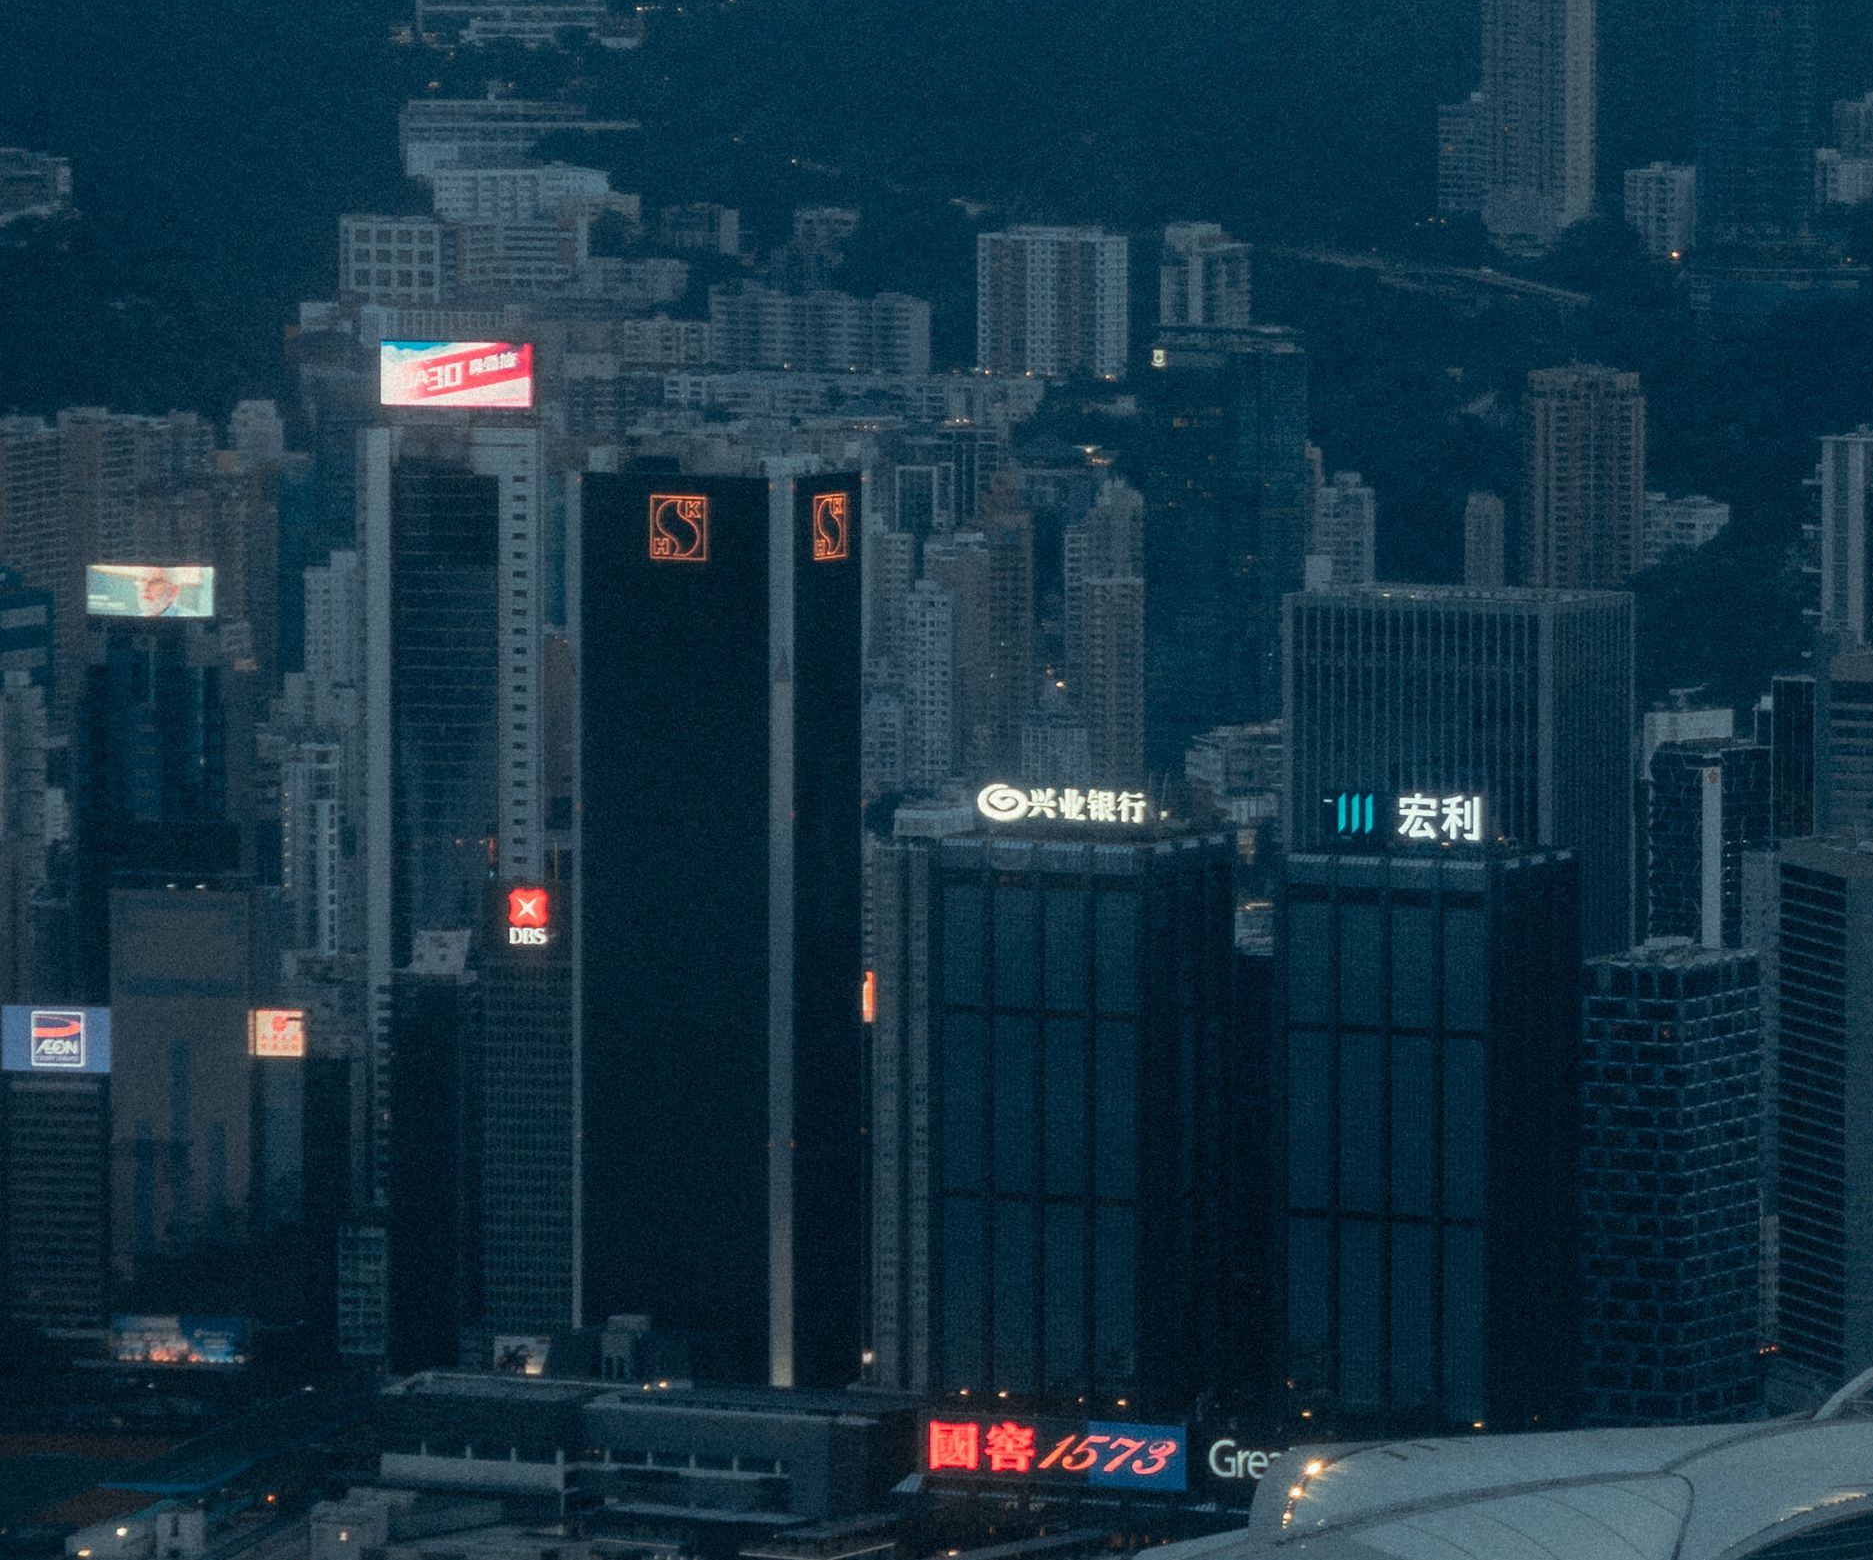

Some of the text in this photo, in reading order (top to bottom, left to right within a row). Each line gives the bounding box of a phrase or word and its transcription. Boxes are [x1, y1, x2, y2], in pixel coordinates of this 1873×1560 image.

[1027, 787, 1147, 824] 兴业银行
[1397, 792, 1480, 841] 宏利
[509, 927, 547, 945] DBS
[928, 1419, 1178, 1477] 國窖 1573
[1209, 1438, 1283, 1480] Gre
